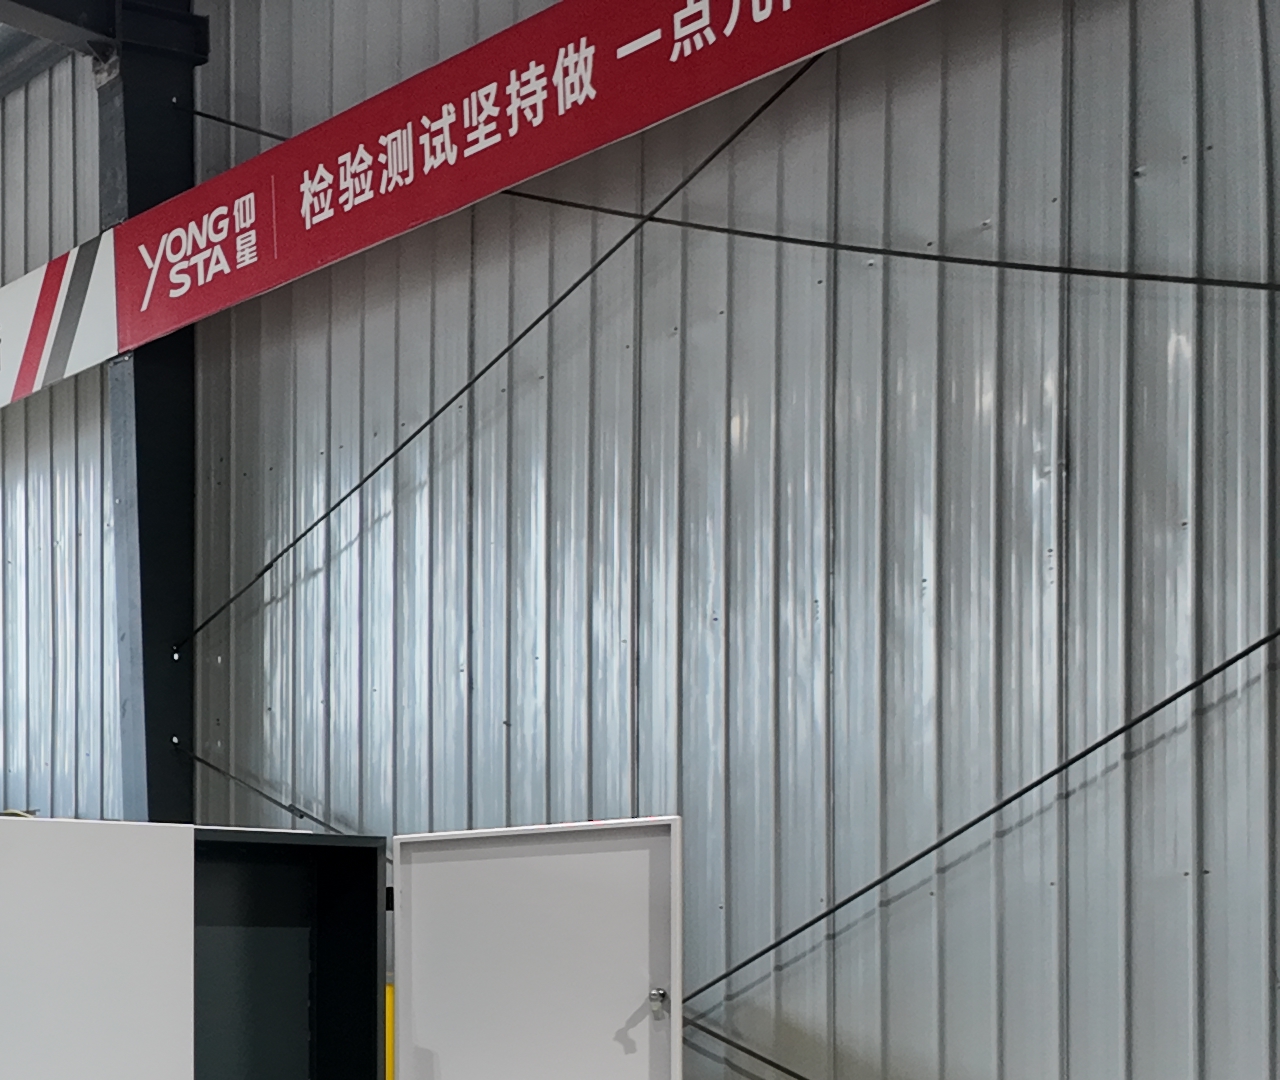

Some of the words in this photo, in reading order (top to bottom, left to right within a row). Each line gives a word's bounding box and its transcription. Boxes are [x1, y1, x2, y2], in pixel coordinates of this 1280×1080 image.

[299, 36, 598, 232] 检验测试坚持做
[137, 205, 230, 313] YONG
[168, 244, 232, 298] STA
[232, 191, 258, 270] 仰星
